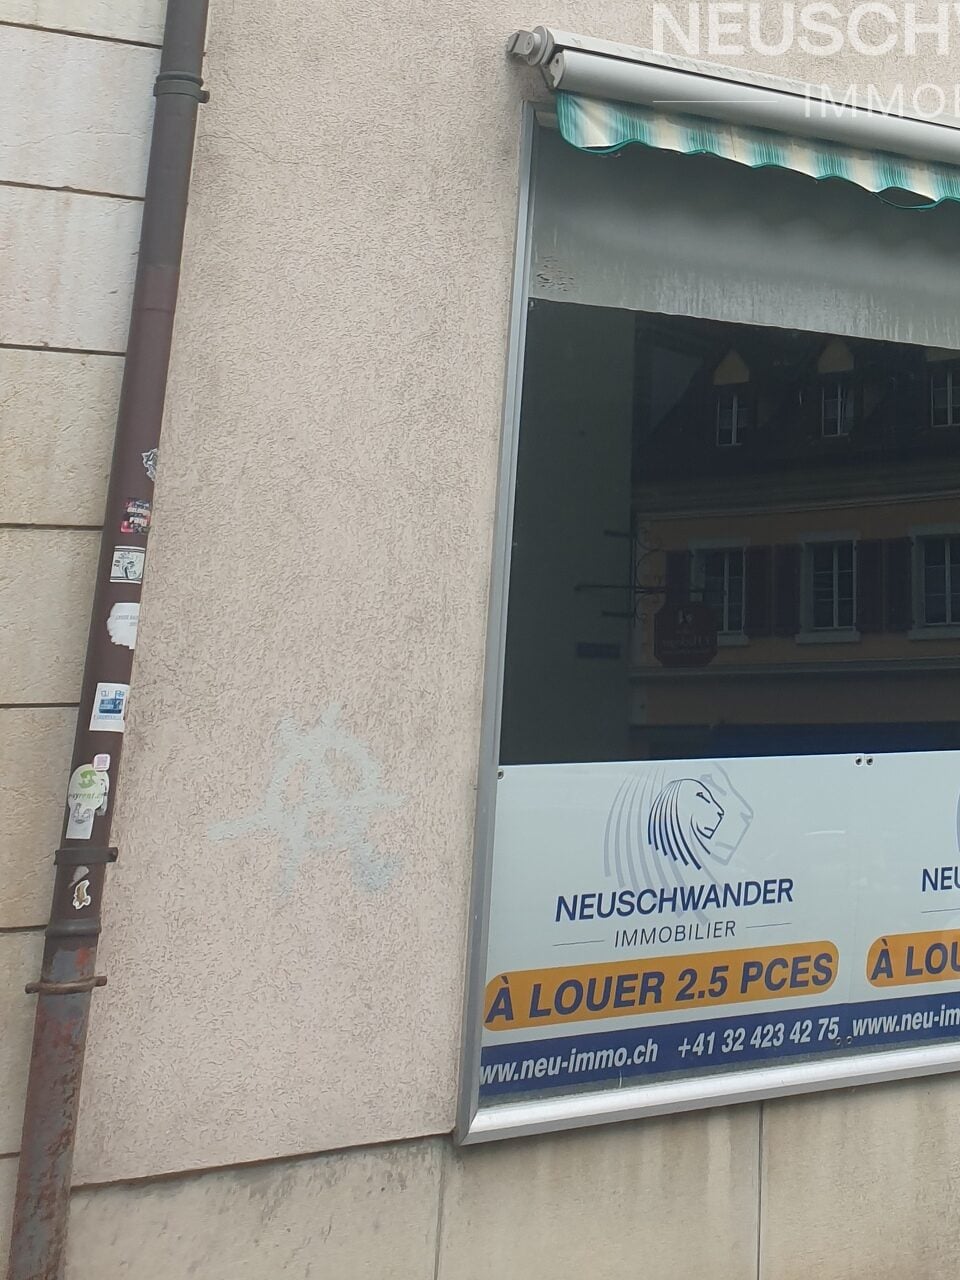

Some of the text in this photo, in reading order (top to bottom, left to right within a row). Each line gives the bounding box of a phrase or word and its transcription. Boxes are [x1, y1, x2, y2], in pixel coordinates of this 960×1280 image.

[555, 878, 794, 922] NEUSCHWANDER
[614, 920, 736, 948] IMMOBILIER
[871, 939, 894, 980] À
[484, 953, 833, 1024] À LOUER 2.5 PCES
[678, 1031, 715, 1059] +41
[721, 1026, 744, 1052] 32
[750, 1022, 785, 1049] 423
[789, 1019, 813, 1044] 42
[818, 1016, 839, 1041] 75
